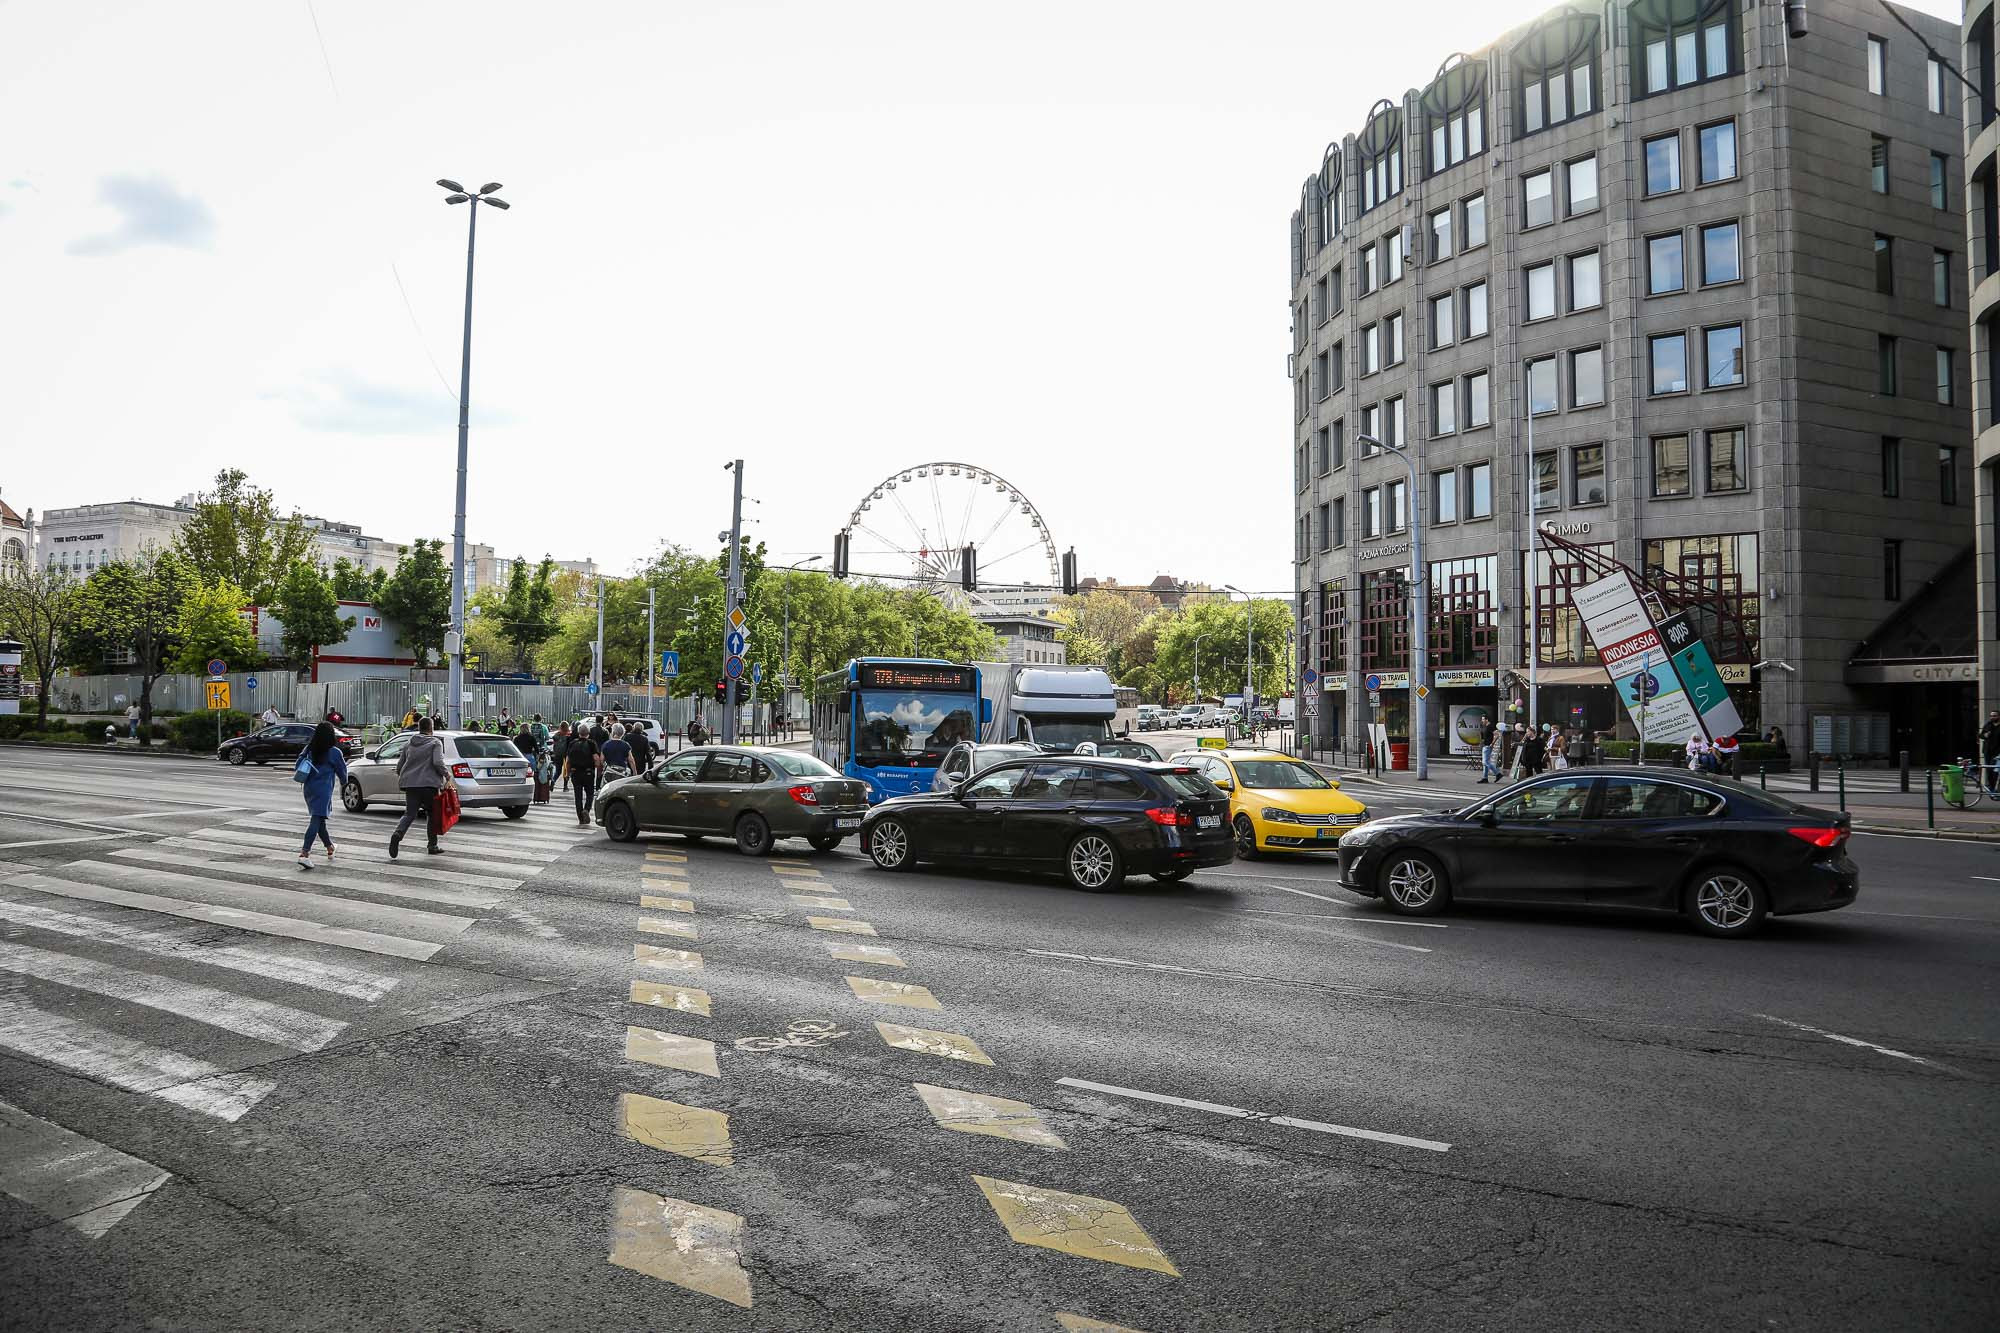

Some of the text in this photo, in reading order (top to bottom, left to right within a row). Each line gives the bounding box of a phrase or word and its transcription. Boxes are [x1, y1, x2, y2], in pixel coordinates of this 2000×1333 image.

[1668, 622, 1689, 644] apps
[1603, 633, 1658, 662] INDONESIA
[1387, 674, 1407, 682] TRAVEL
[1438, 671, 1491, 680] ANUBIS TRAVEL
[1720, 665, 1745, 681] Bar
[1913, 668, 1954, 679] CITY
